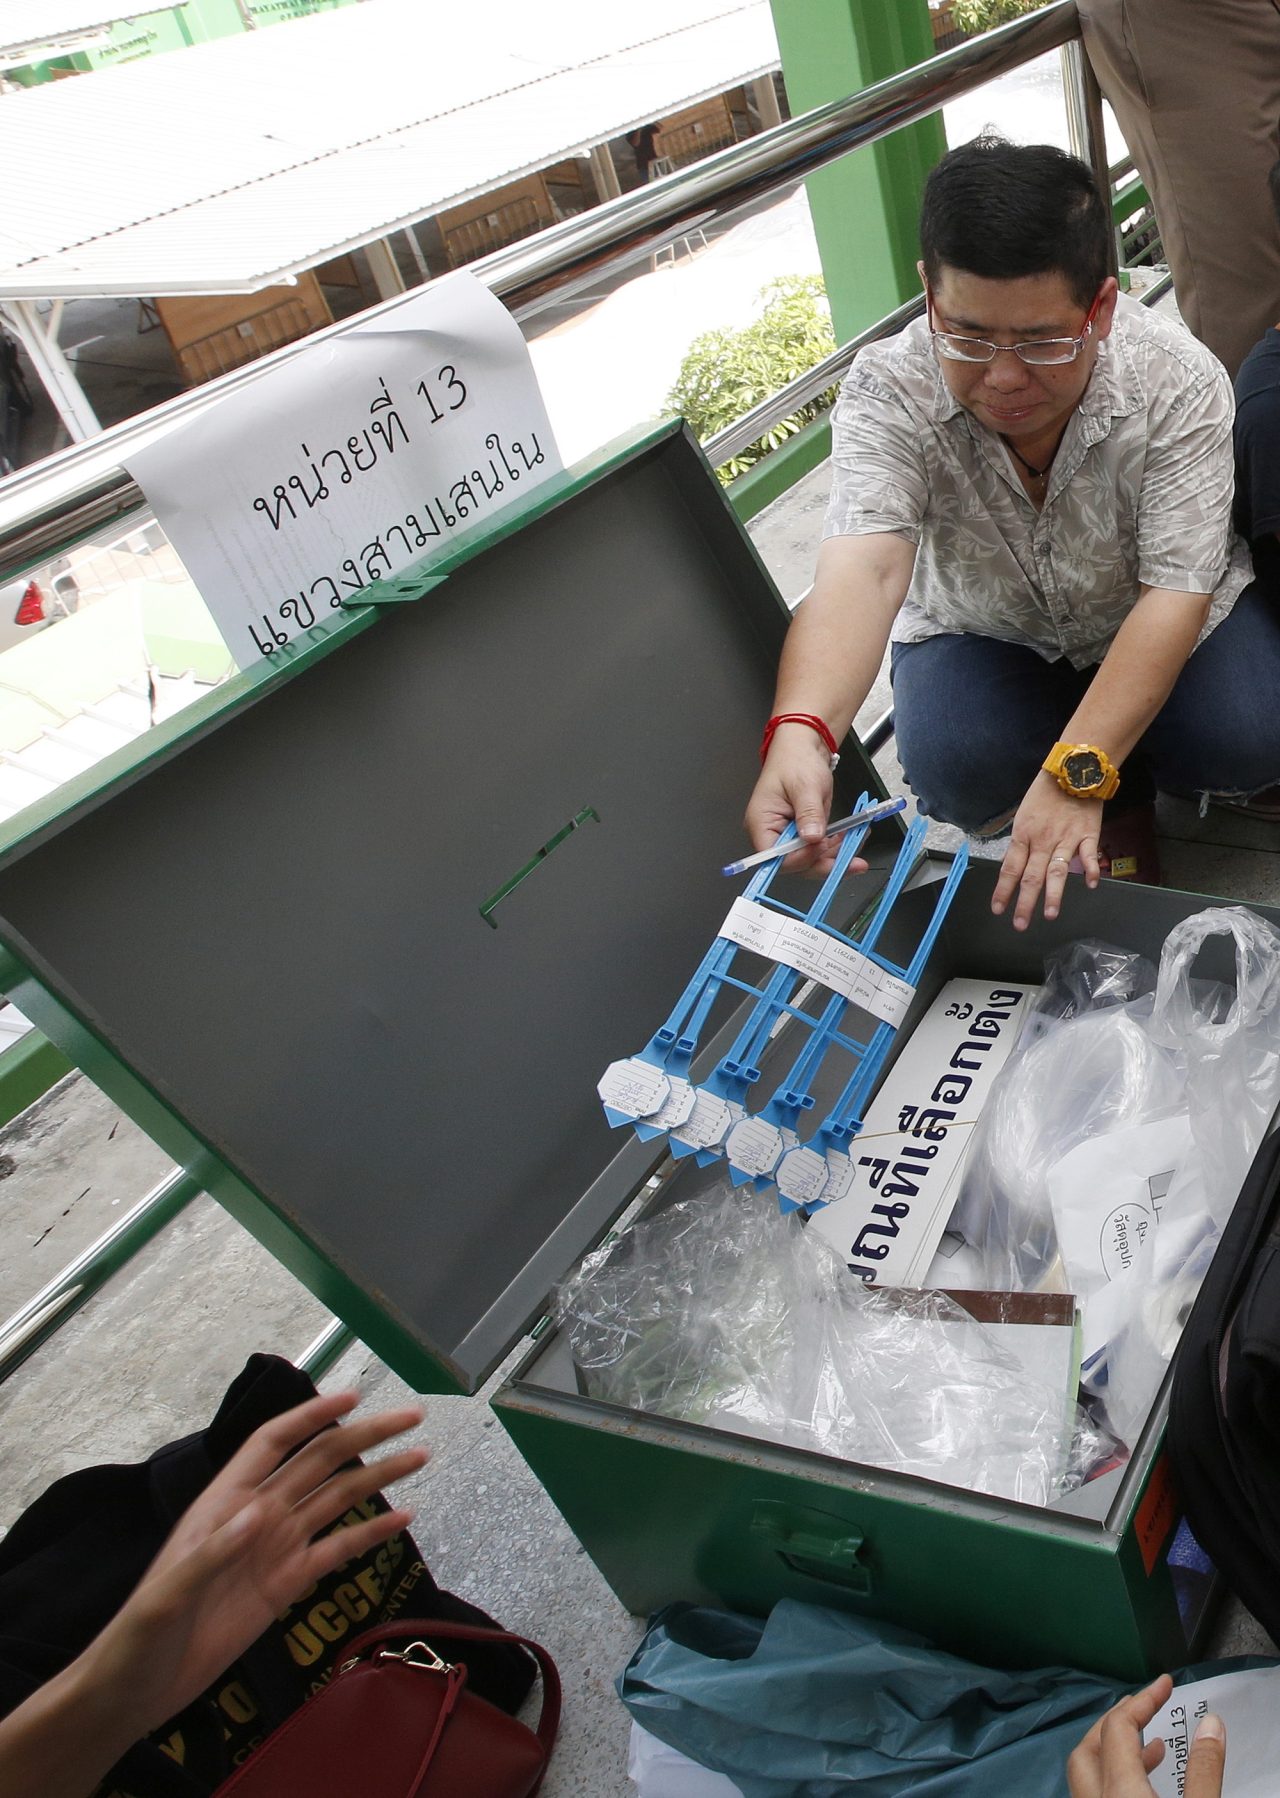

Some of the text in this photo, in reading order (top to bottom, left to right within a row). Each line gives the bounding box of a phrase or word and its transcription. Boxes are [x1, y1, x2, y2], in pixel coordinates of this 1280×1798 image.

[253, 364, 467, 531] หน่วยที่ 13
[247, 432, 546, 656] แขวงสามเสนใน
[284, 1537, 406, 1667] UCCESS
[380, 1560, 428, 1624] ENTER
[1171, 1706, 1185, 1728] 13
